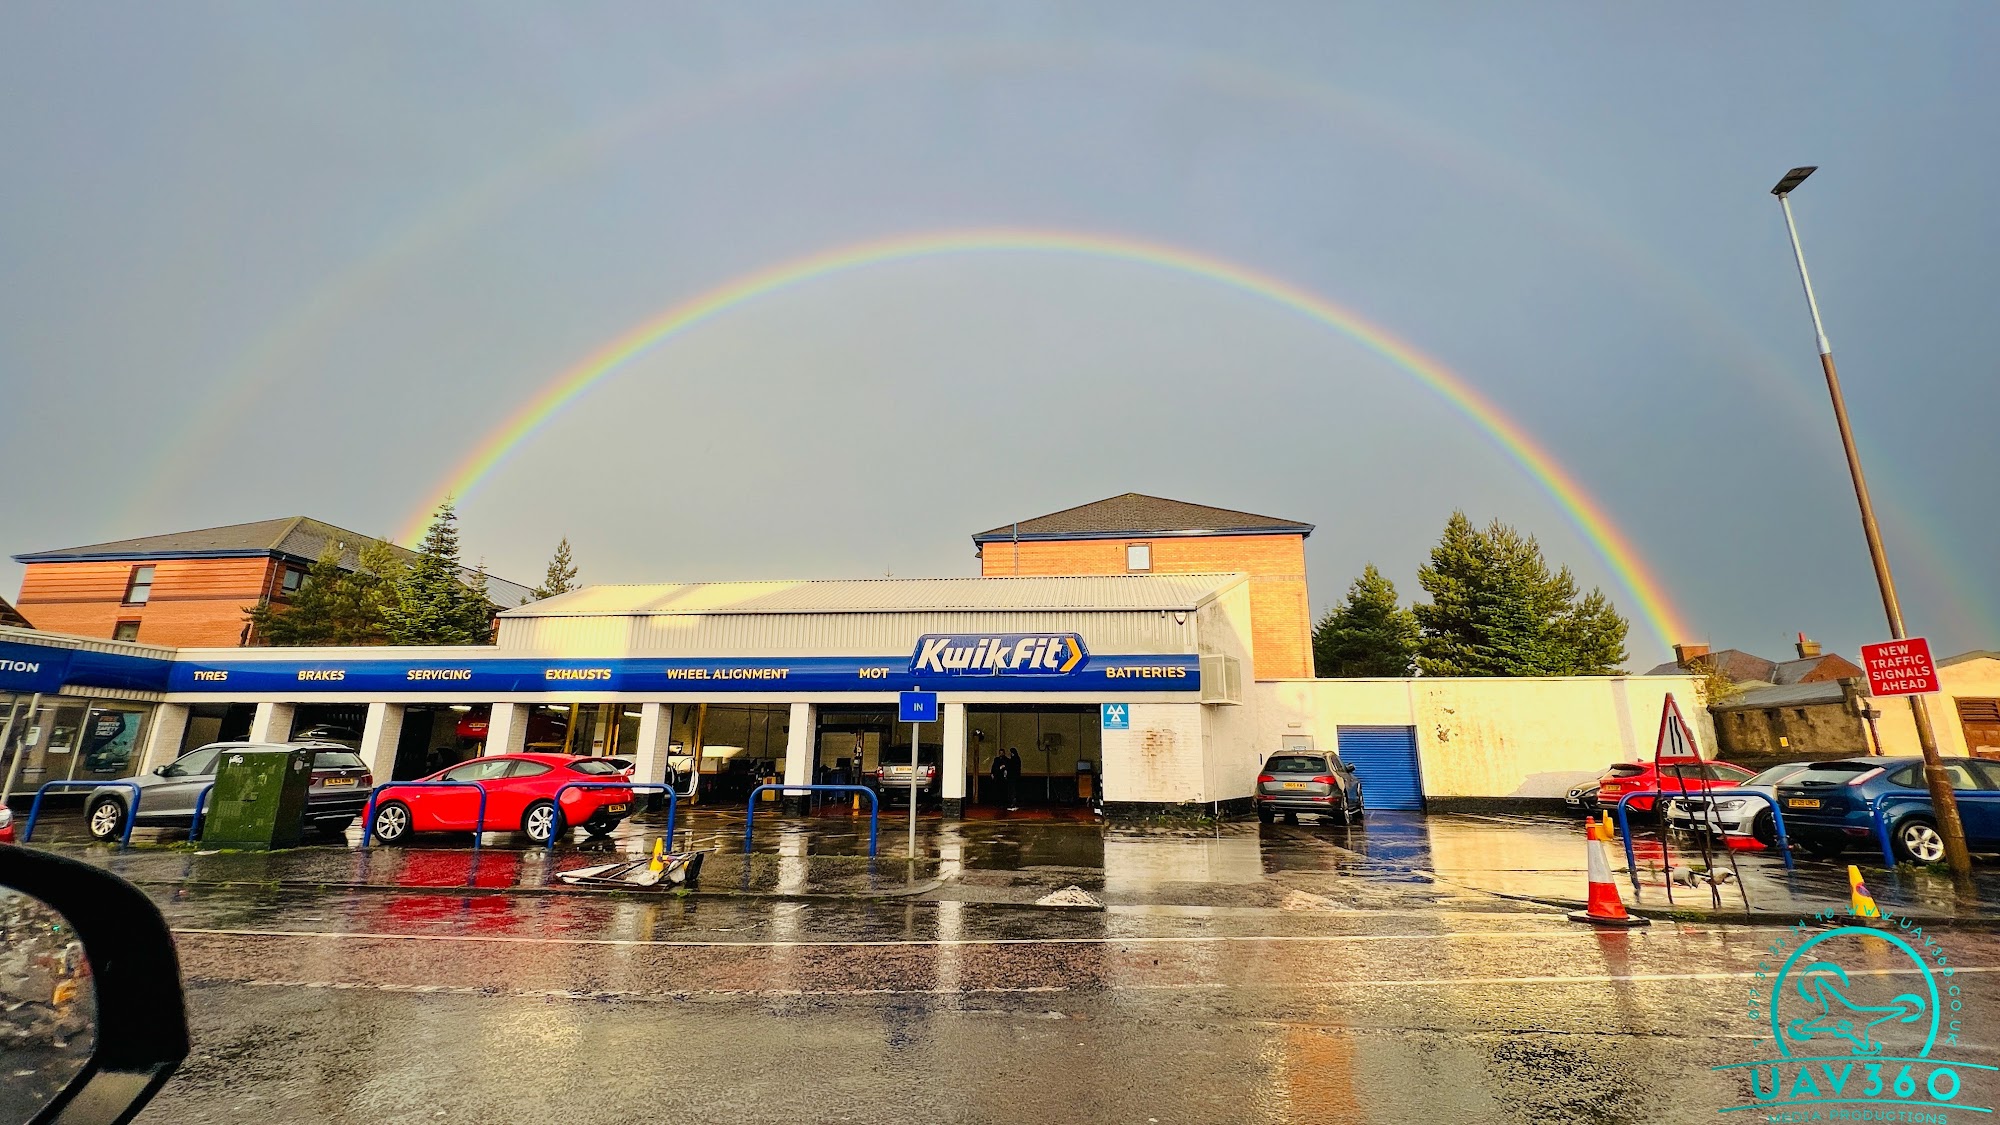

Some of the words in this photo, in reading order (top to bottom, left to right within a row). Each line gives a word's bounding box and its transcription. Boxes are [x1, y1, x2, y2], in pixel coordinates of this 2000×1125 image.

[1878, 644, 1909, 657] NEW
[1870, 654, 1926, 670] TRAFFIC
[193, 670, 229, 682] TYRES
[297, 670, 346, 681] BRAKES
[406, 669, 472, 681] SERVICING
[545, 669, 612, 680] EXHAUSTS
[667, 669, 711, 680] WHEEL
[713, 668, 790, 680] ALIGNMENT
[859, 668, 890, 679] MOT
[1106, 666, 1187, 679] BATTERIES
[1872, 666, 1931, 681] SIGNALS
[1882, 678, 1927, 692] AHEAD
[913, 702, 924, 712] IN
